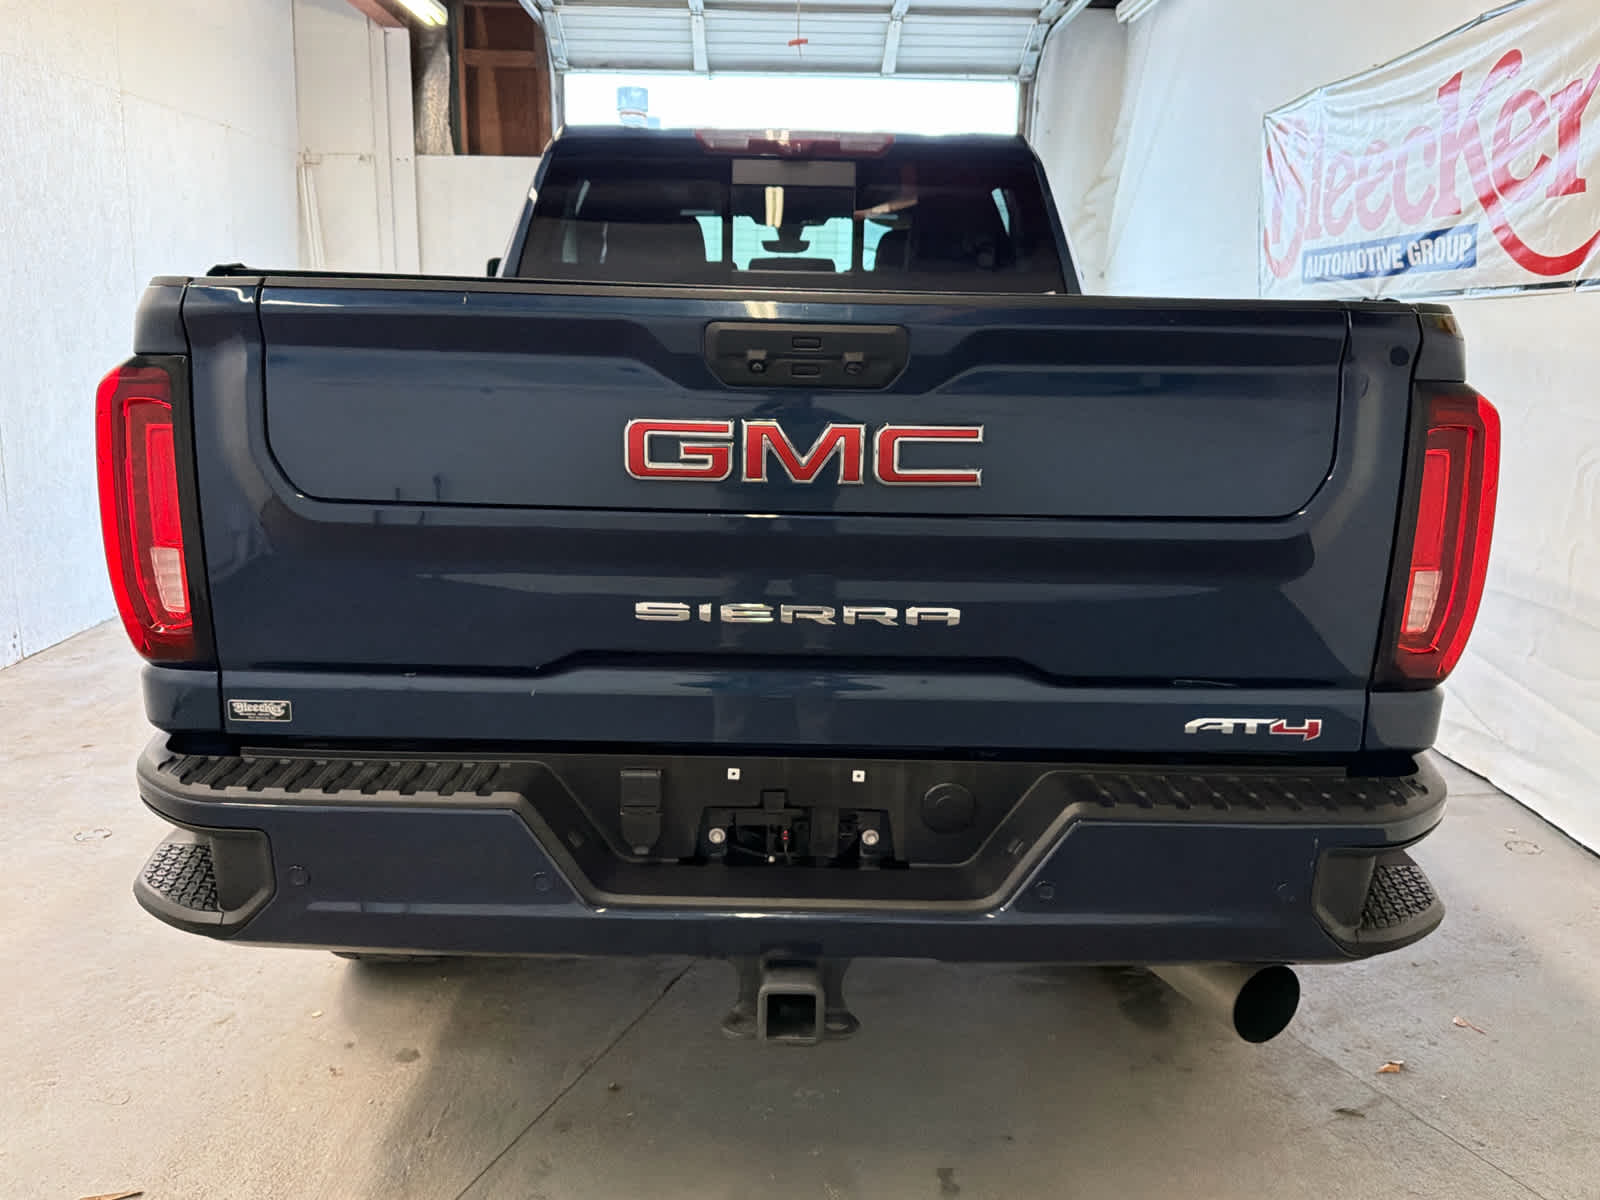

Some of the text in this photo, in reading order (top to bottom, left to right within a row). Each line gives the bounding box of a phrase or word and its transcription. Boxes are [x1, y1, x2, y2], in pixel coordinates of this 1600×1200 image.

[1304, 232, 1473, 279] AUTOMOTIVE GROUP
[624, 418, 984, 487] GMC
[634, 601, 961, 626] SIERRA
[1184, 717, 1323, 742] AT4
